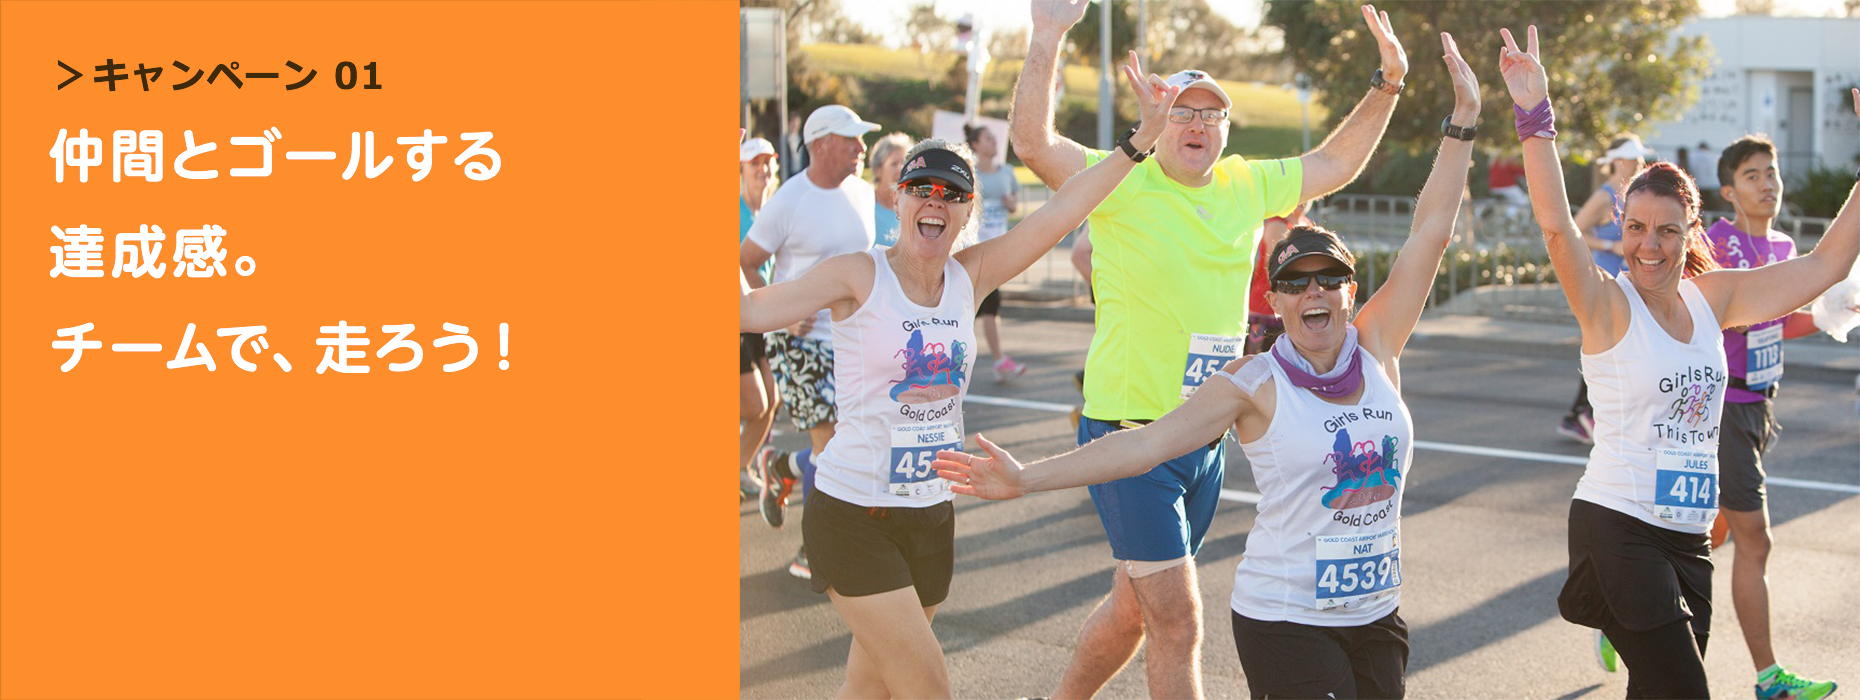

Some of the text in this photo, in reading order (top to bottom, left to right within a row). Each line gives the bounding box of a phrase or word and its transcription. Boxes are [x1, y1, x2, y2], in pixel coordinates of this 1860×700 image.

[1659, 366, 1702, 394] Girls
[900, 399, 956, 422] Gold Coast
[1323, 407, 1393, 434] Girls Run
[917, 431, 945, 443] NESSIE
[1653, 423, 1688, 444] This
[1683, 459, 1708, 470] JULES
[1670, 475, 1711, 505] 414
[1333, 500, 1393, 527] Gold Coast
[1353, 543, 1373, 555] NAT
[1318, 556, 1391, 594] 4539
